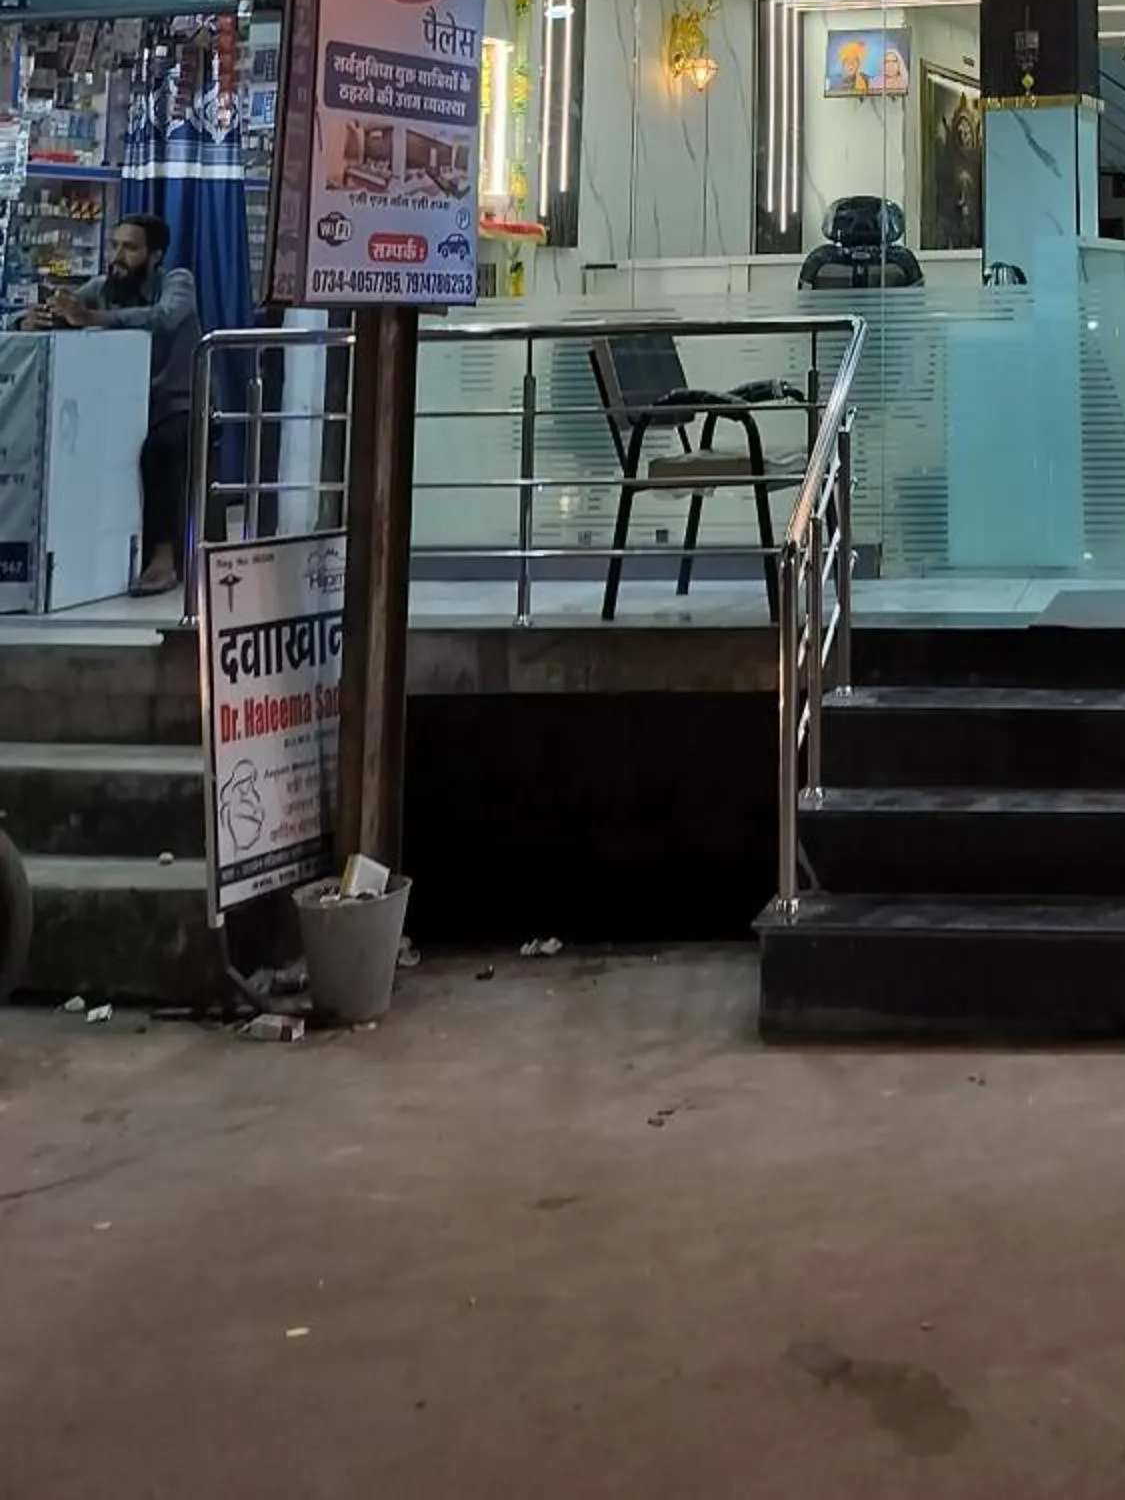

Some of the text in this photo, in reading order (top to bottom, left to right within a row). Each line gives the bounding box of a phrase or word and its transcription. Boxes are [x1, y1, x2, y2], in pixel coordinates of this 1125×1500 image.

[423, 5, 477, 59] पैलेस
[220, 704, 242, 743] Dr.
[244, 694, 312, 738] Haleema
